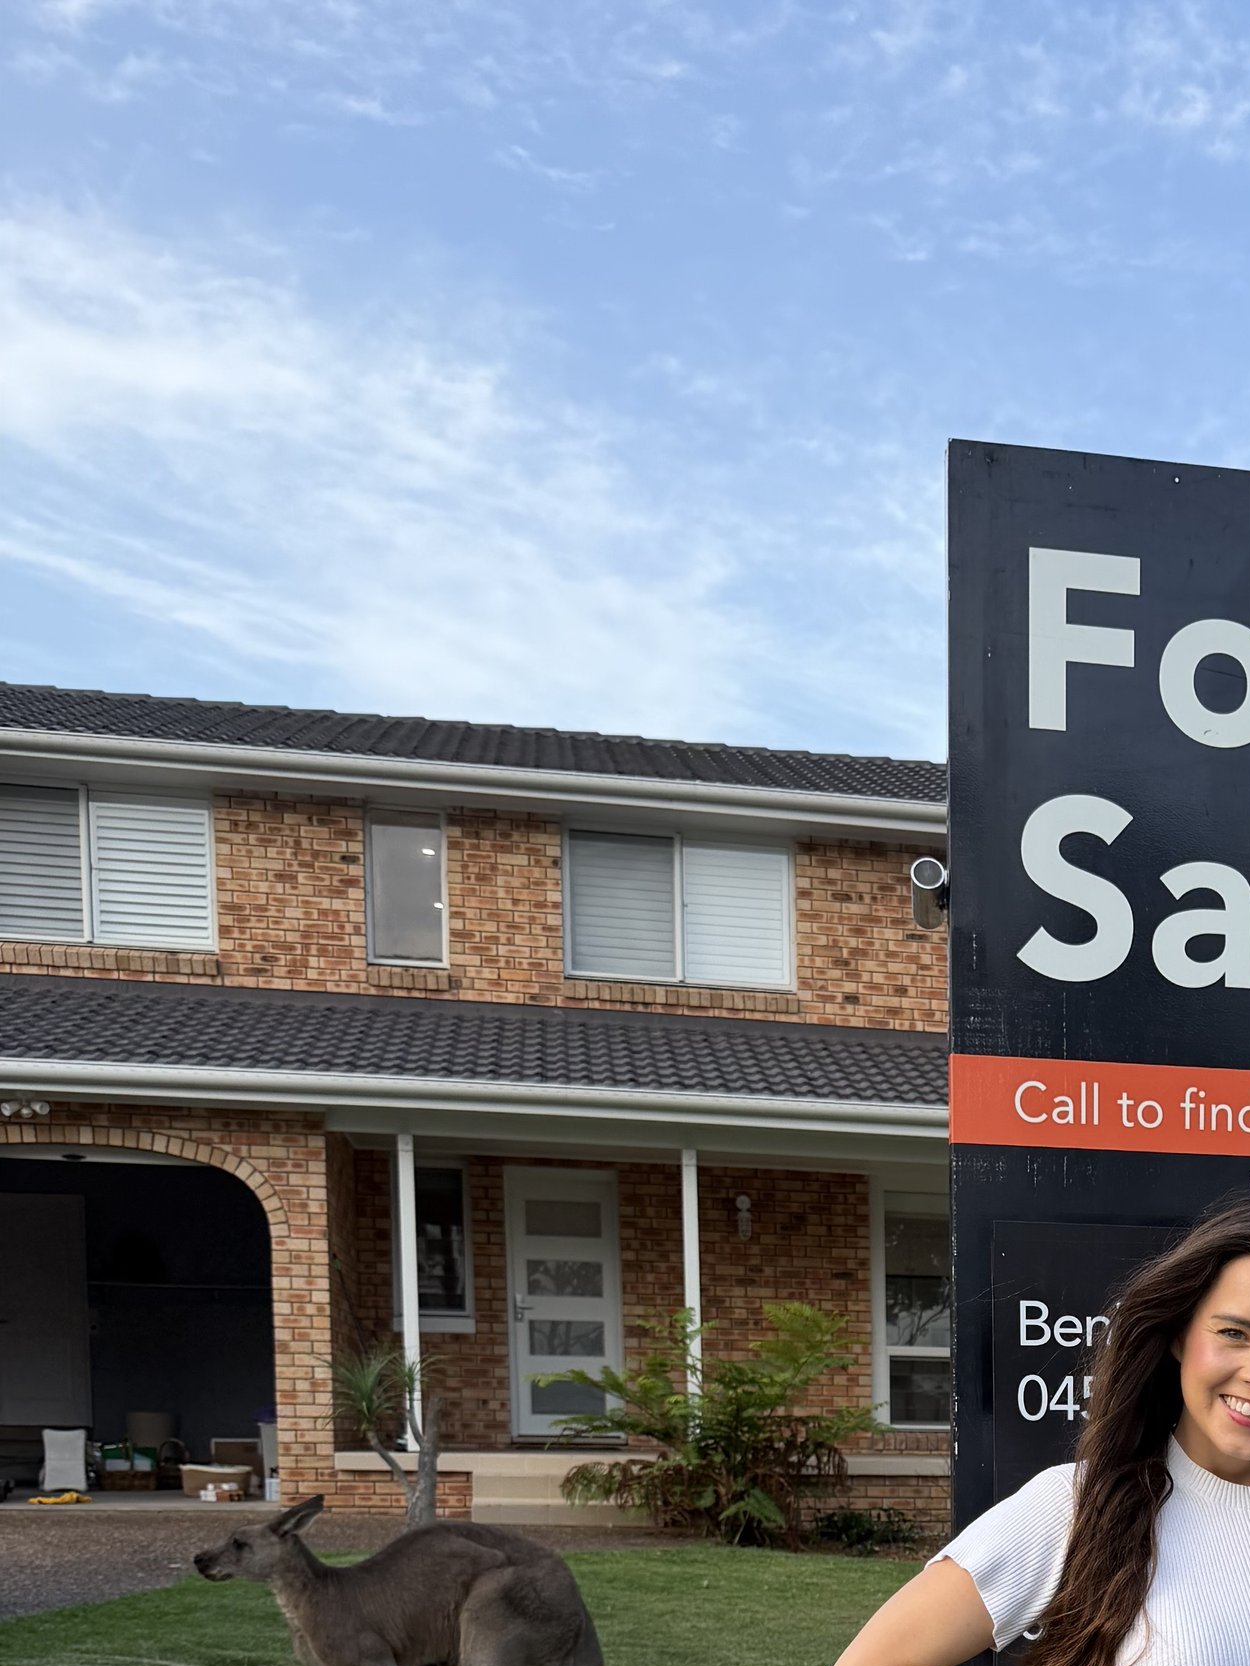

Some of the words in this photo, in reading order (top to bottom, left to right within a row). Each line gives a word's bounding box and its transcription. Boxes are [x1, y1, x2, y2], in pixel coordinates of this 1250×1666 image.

[1014, 1080, 1099, 1125] Call
[1117, 1091, 1164, 1129] to
[1019, 1300, 1120, 1348] Ben
